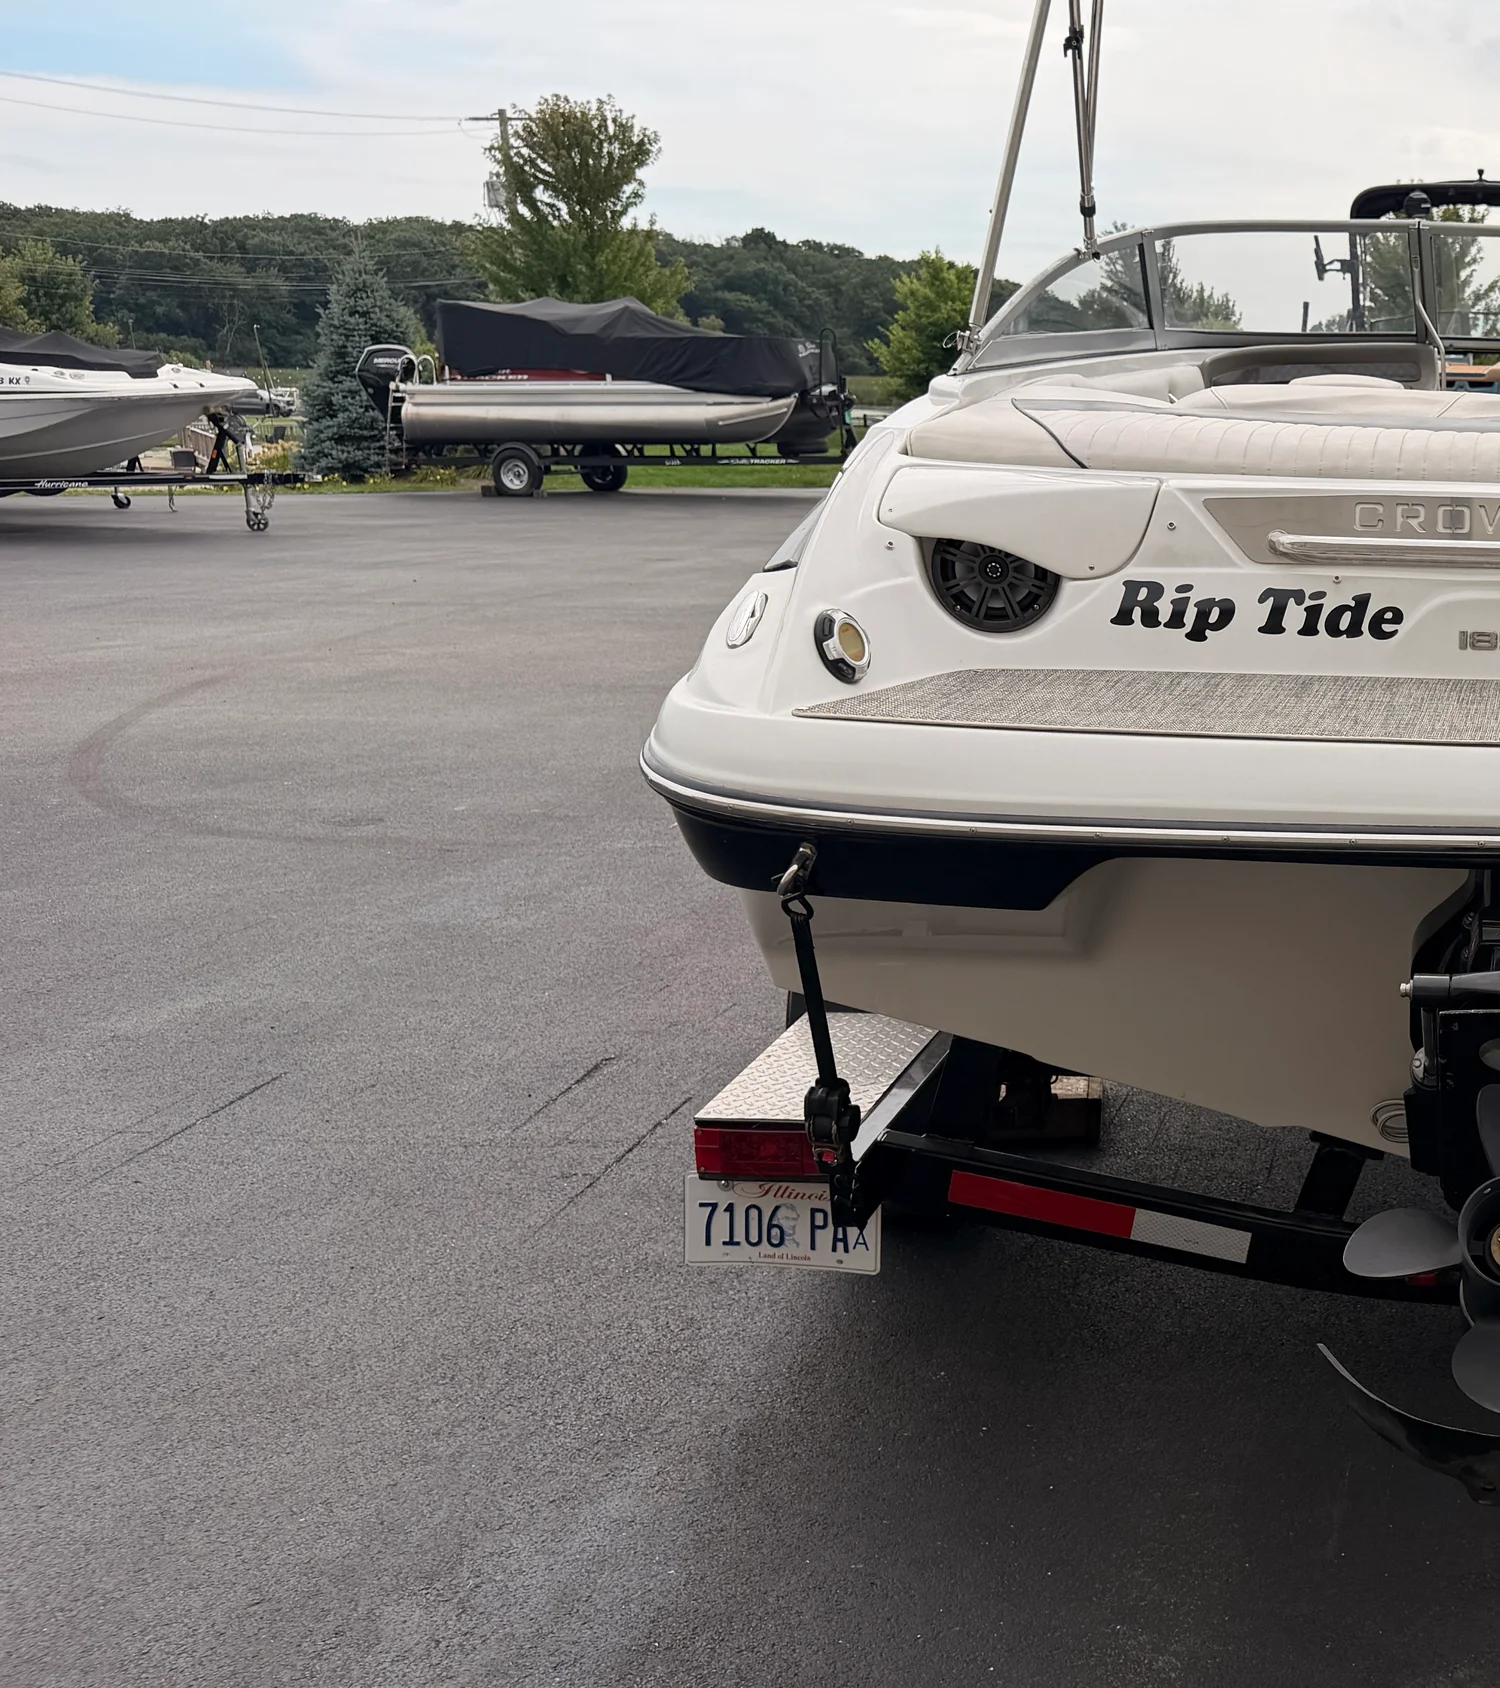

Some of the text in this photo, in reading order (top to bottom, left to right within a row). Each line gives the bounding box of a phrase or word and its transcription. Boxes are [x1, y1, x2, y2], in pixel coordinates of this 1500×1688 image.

[8, 377, 22, 385] KX
[35, 479, 89, 488] Hurricane
[1110, 580, 1404, 642] Rip Tide
[698, 1202, 785, 1248] 7106
[758, 1251, 776, 1260] Land
